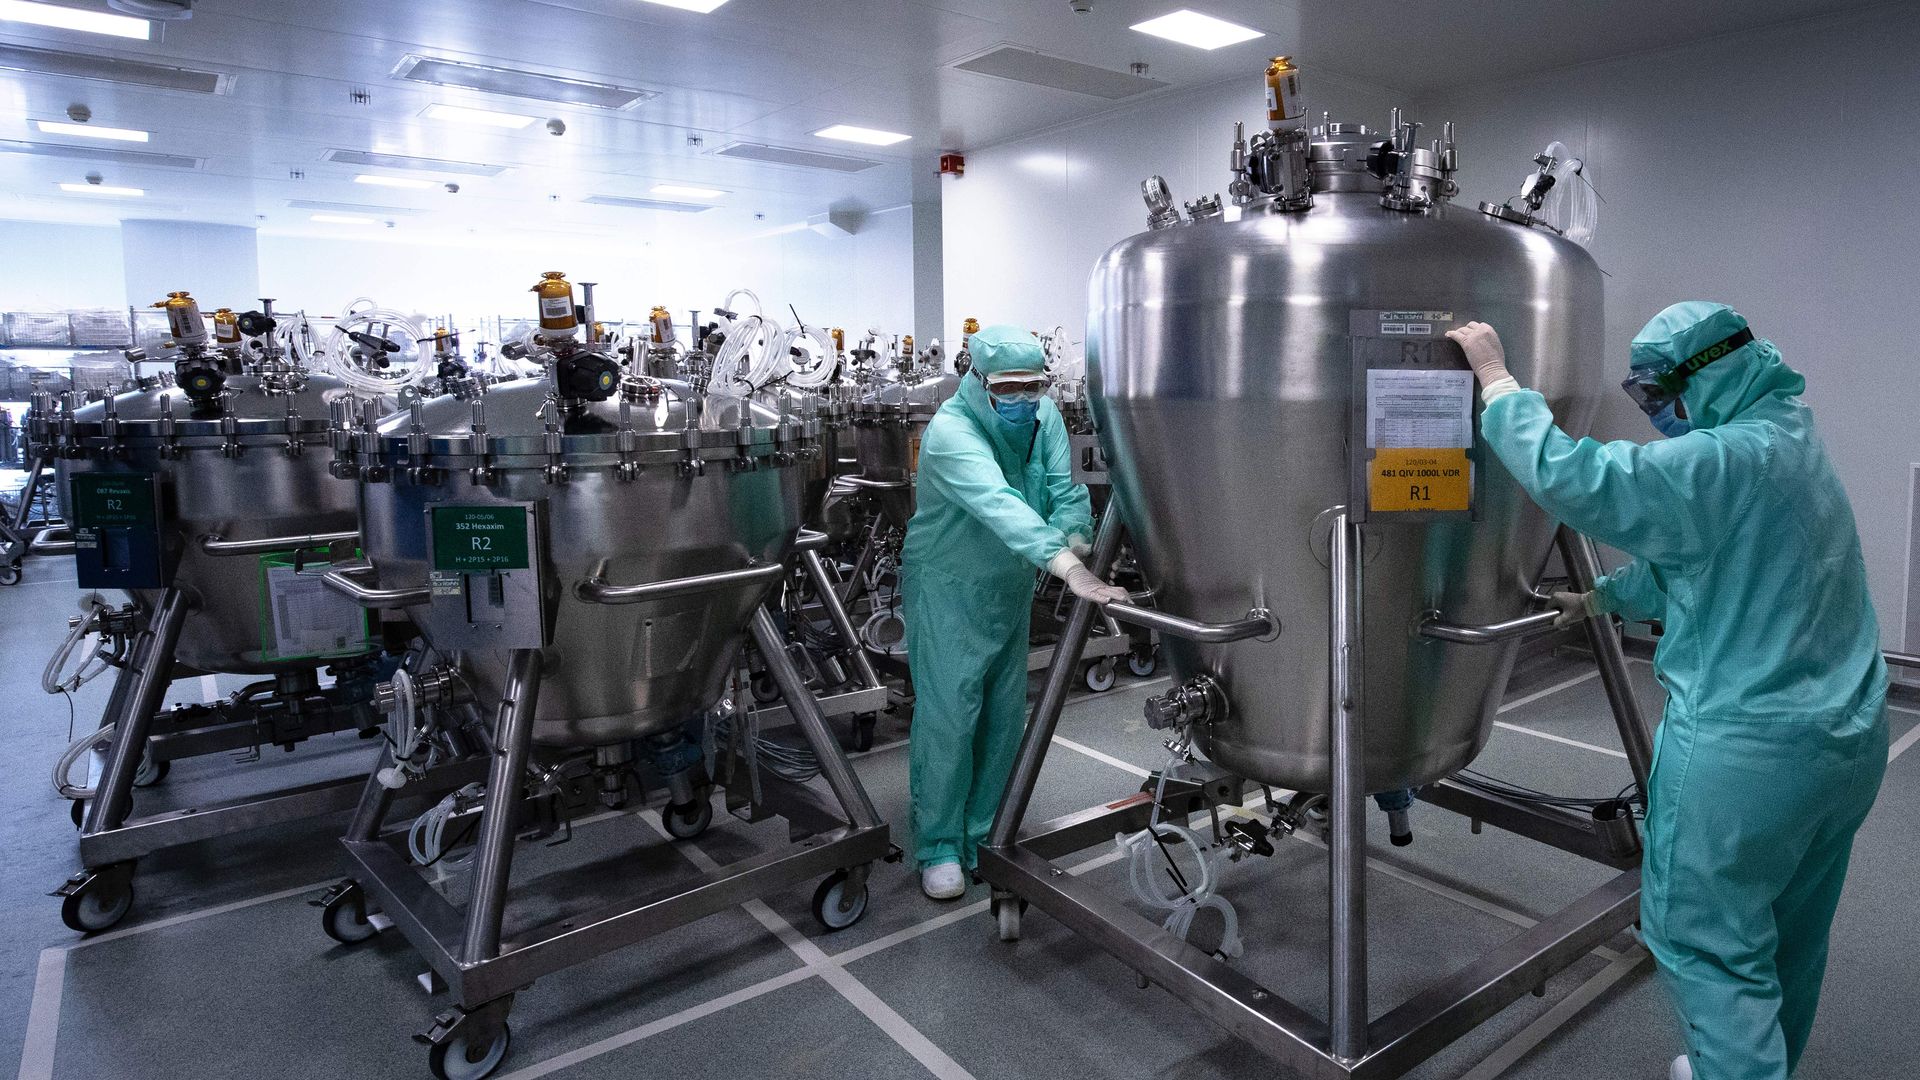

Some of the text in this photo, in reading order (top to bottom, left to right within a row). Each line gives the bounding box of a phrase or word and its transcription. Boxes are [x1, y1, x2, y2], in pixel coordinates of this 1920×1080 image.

[1401, 341, 1432, 363] R1
[1685, 339, 1733, 371] uvex
[1381, 469, 1460, 477] 481 QIV 1000L VDR
[1410, 485, 1431, 501] R1
[107, 499, 123, 511] R2
[471, 536, 492, 550] R2
